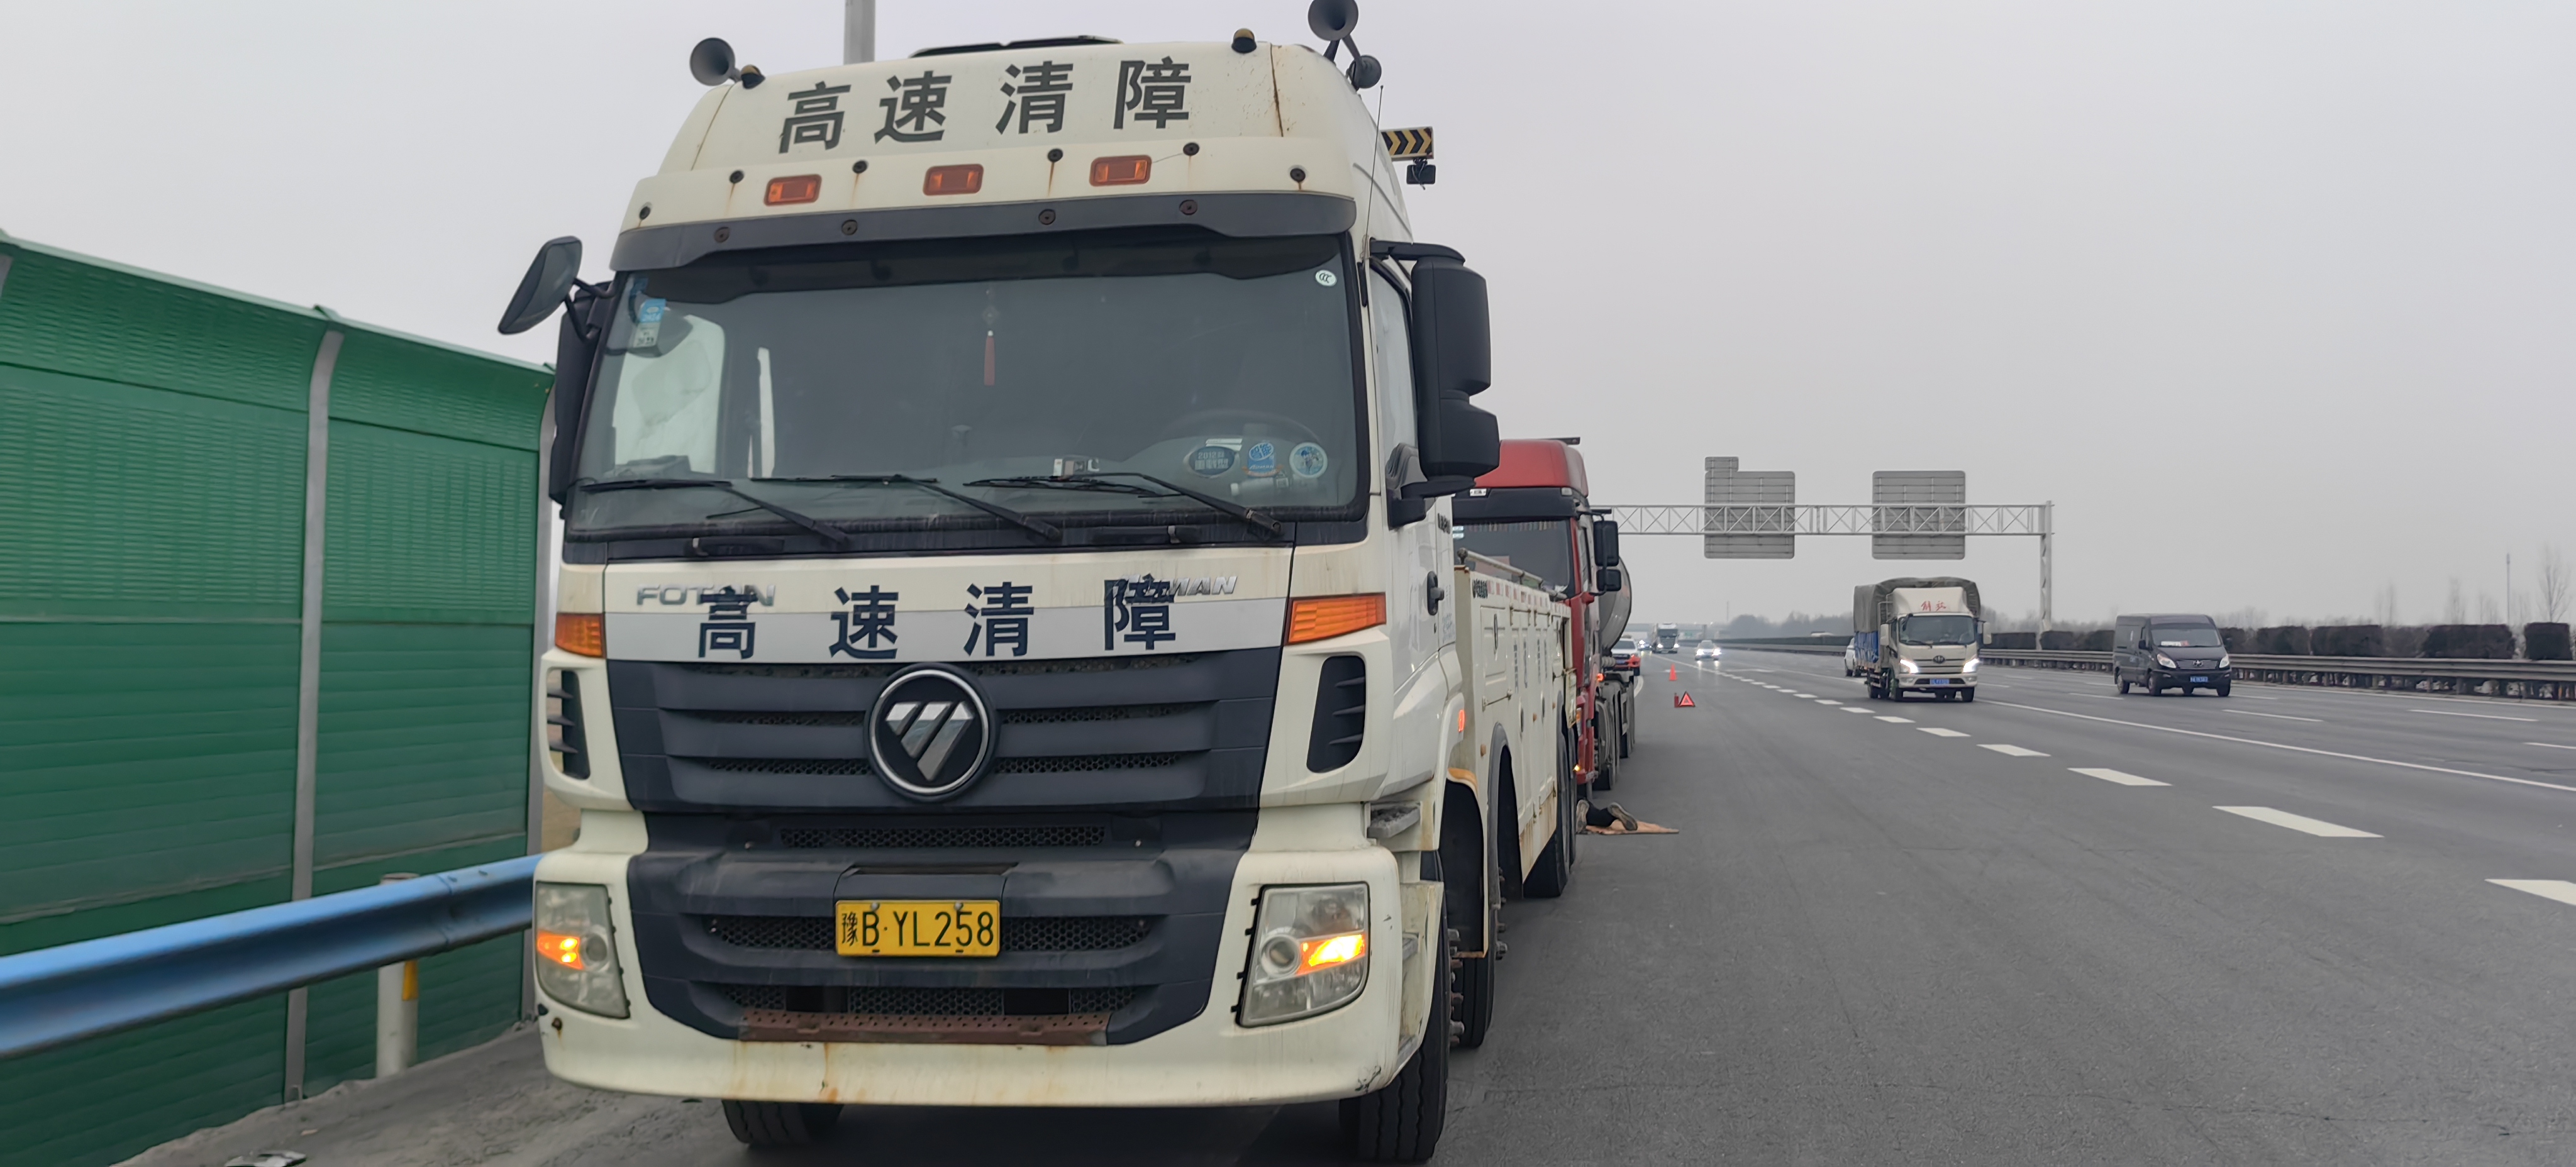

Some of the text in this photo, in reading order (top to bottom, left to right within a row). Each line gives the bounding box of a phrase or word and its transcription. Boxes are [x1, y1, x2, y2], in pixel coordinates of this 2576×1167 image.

[778, 56, 1192, 154] 高速清障
[698, 573, 1176, 660] 高速清障
